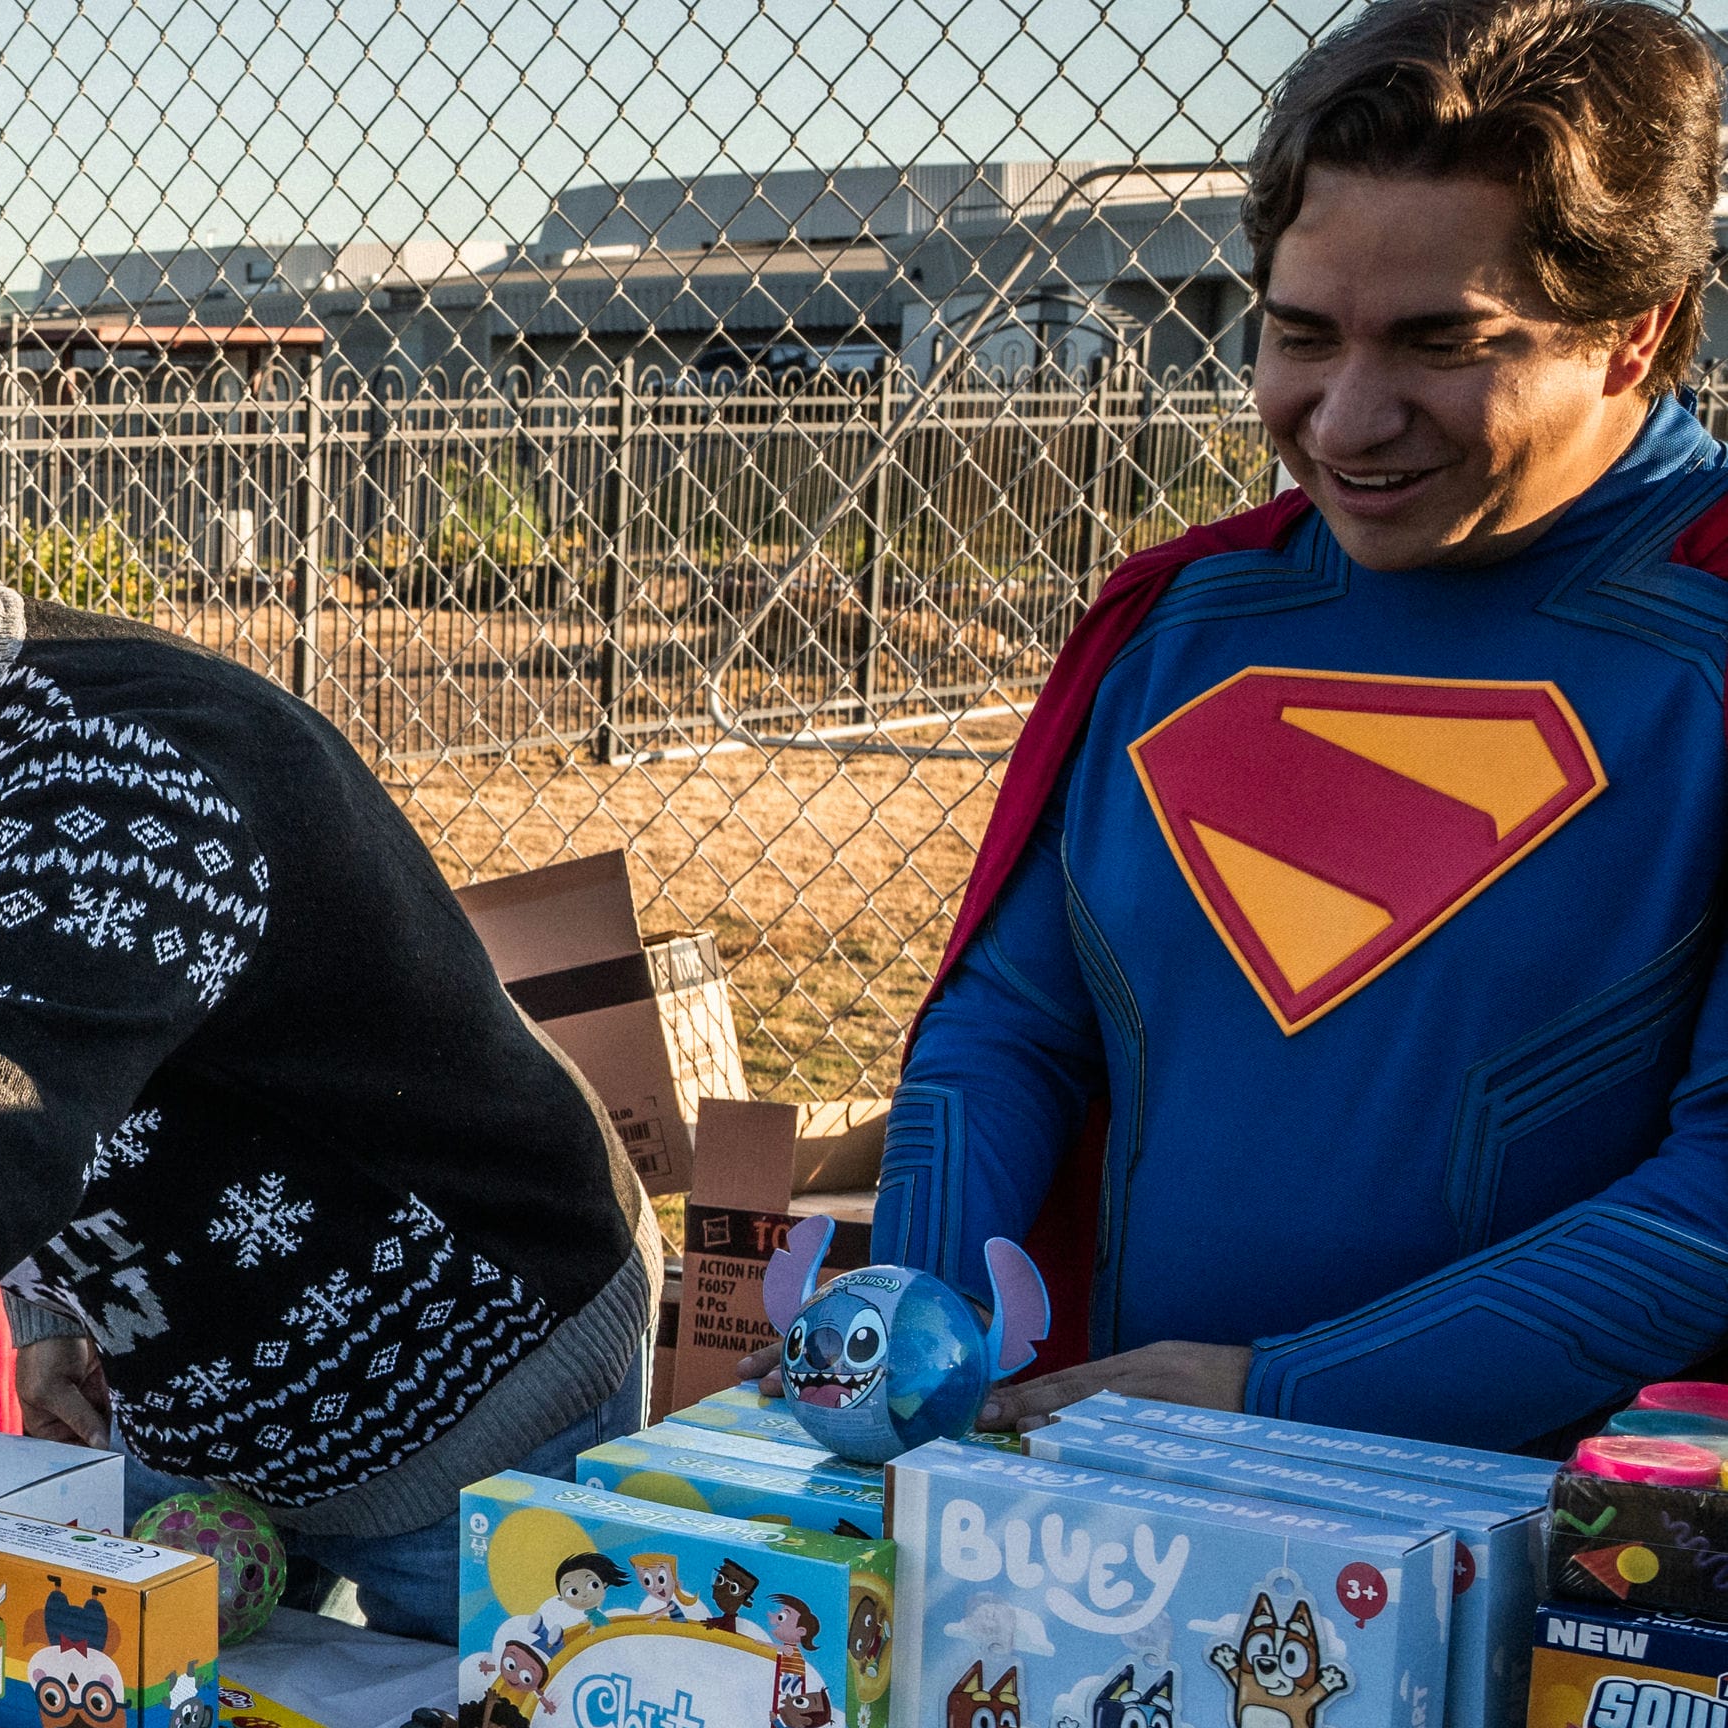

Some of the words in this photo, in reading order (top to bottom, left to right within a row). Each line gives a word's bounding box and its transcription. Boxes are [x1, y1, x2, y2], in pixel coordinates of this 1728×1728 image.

[699, 1260, 745, 1279] ACTION
[698, 1278, 736, 1295] F6057
[696, 1297, 703, 1310] 4
[707, 1298, 727, 1312] Pcs
[696, 1314, 715, 1329] INJ
[717, 1317, 733, 1330] AS
[694, 1332, 745, 1352] INDIANA
[1132, 1408, 1263, 1434] BLUEY
[1265, 1430, 1426, 1461] WINDOW
[1421, 1455, 1502, 1473] ART
[1104, 1433, 1231, 1461] BLUEY
[1228, 1459, 1381, 1494] WINDOW
[1375, 1489, 1454, 1508] ART
[553, 1489, 669, 1527] Ladders
[970, 1458, 1105, 1488] BLUEY
[1108, 1483, 1272, 1520] WINDOW
[1270, 1514, 1353, 1534] ART
[940, 1498, 1190, 1635] BLUEY
[1344, 1578, 1379, 1602] 3+
[1547, 1618, 1649, 1659] NEW
